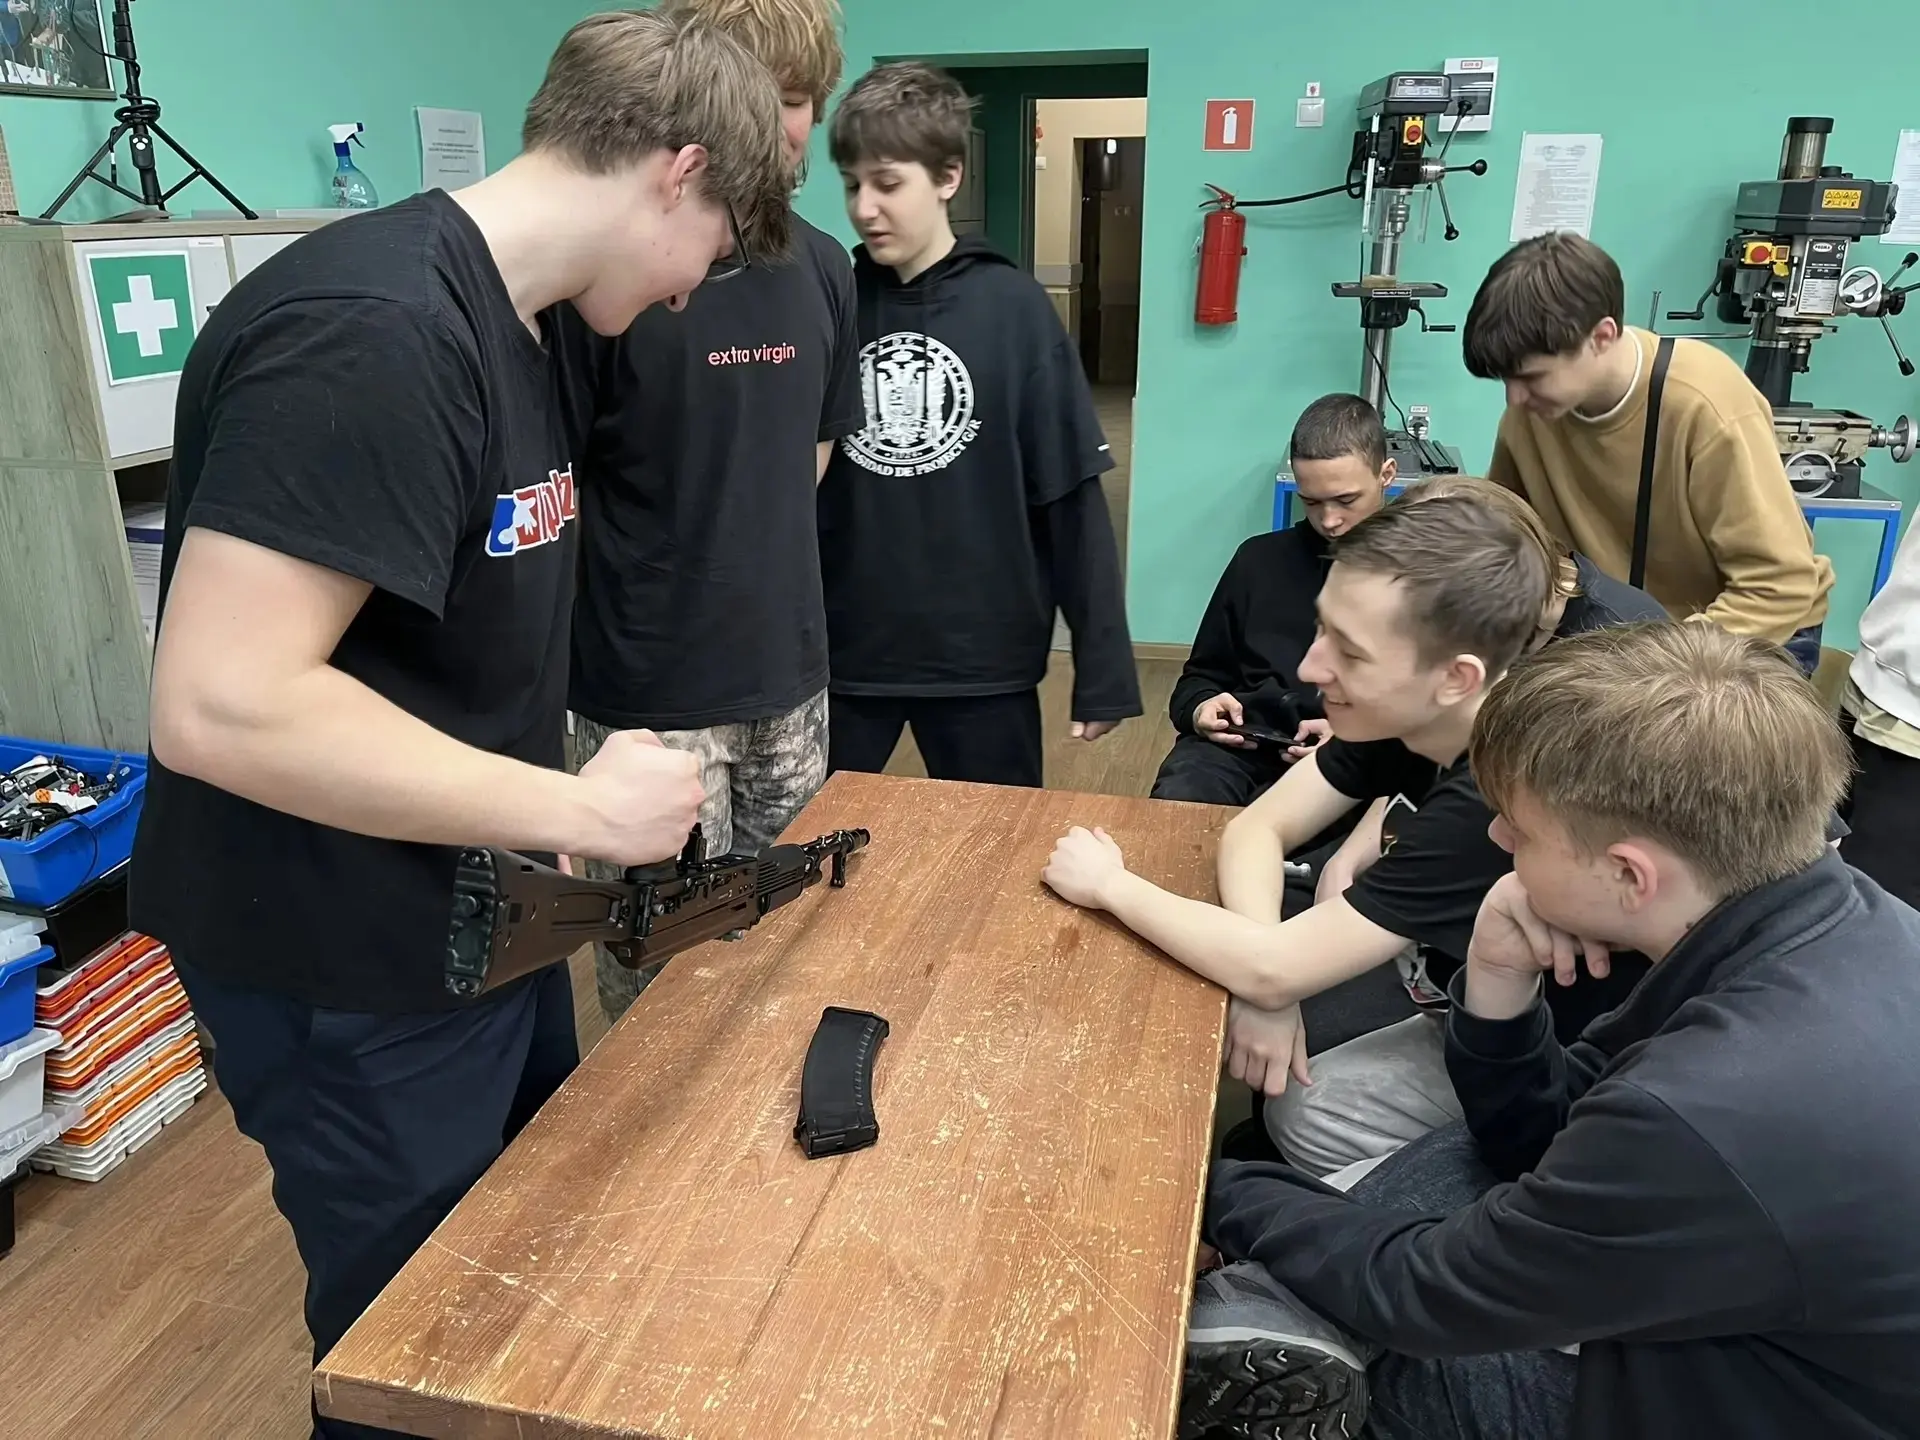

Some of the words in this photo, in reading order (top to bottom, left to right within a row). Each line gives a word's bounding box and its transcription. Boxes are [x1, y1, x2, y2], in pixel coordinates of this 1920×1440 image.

[708, 346, 750, 366] extra
[753, 342, 796, 364] virgin
[841, 442, 895, 476] ERSIDAD
[894, 466, 915, 477] DE
[915, 439, 966, 475] PROJECT
